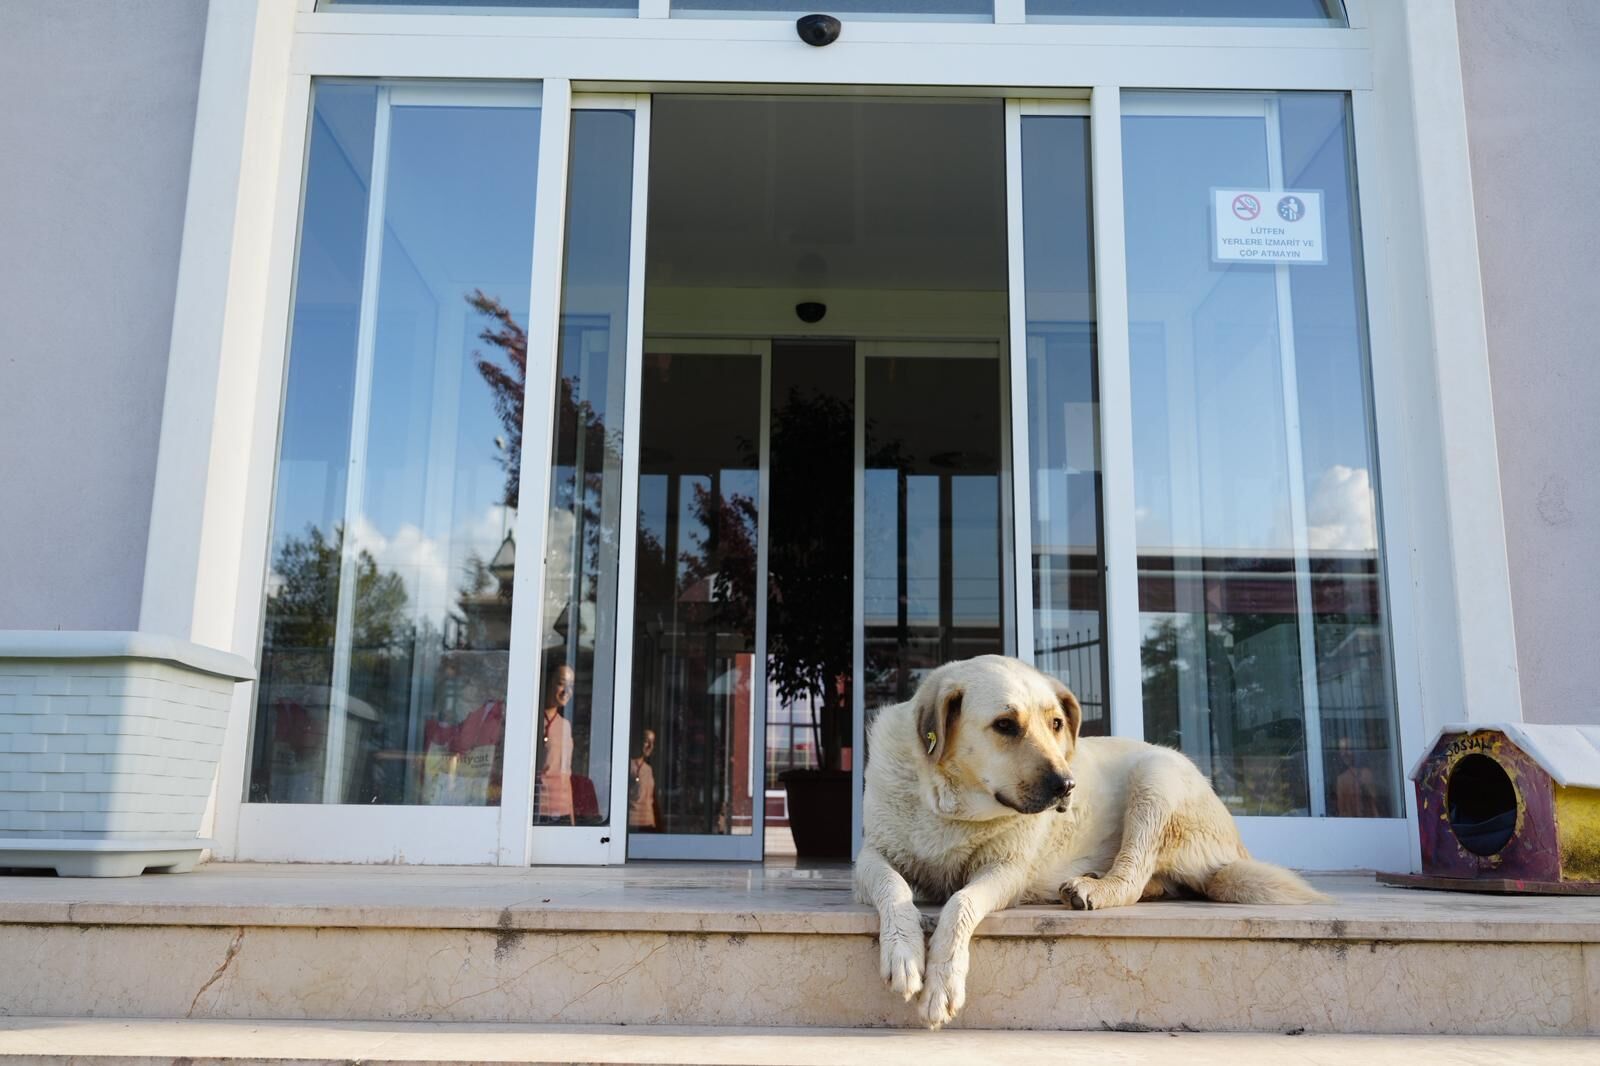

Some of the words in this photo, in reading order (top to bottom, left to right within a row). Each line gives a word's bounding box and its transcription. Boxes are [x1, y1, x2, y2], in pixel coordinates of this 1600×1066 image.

[1221, 237, 1263, 246] YERLERE
[1303, 239, 1314, 247] VE
[1260, 249, 1301, 258] ATMAYIN
